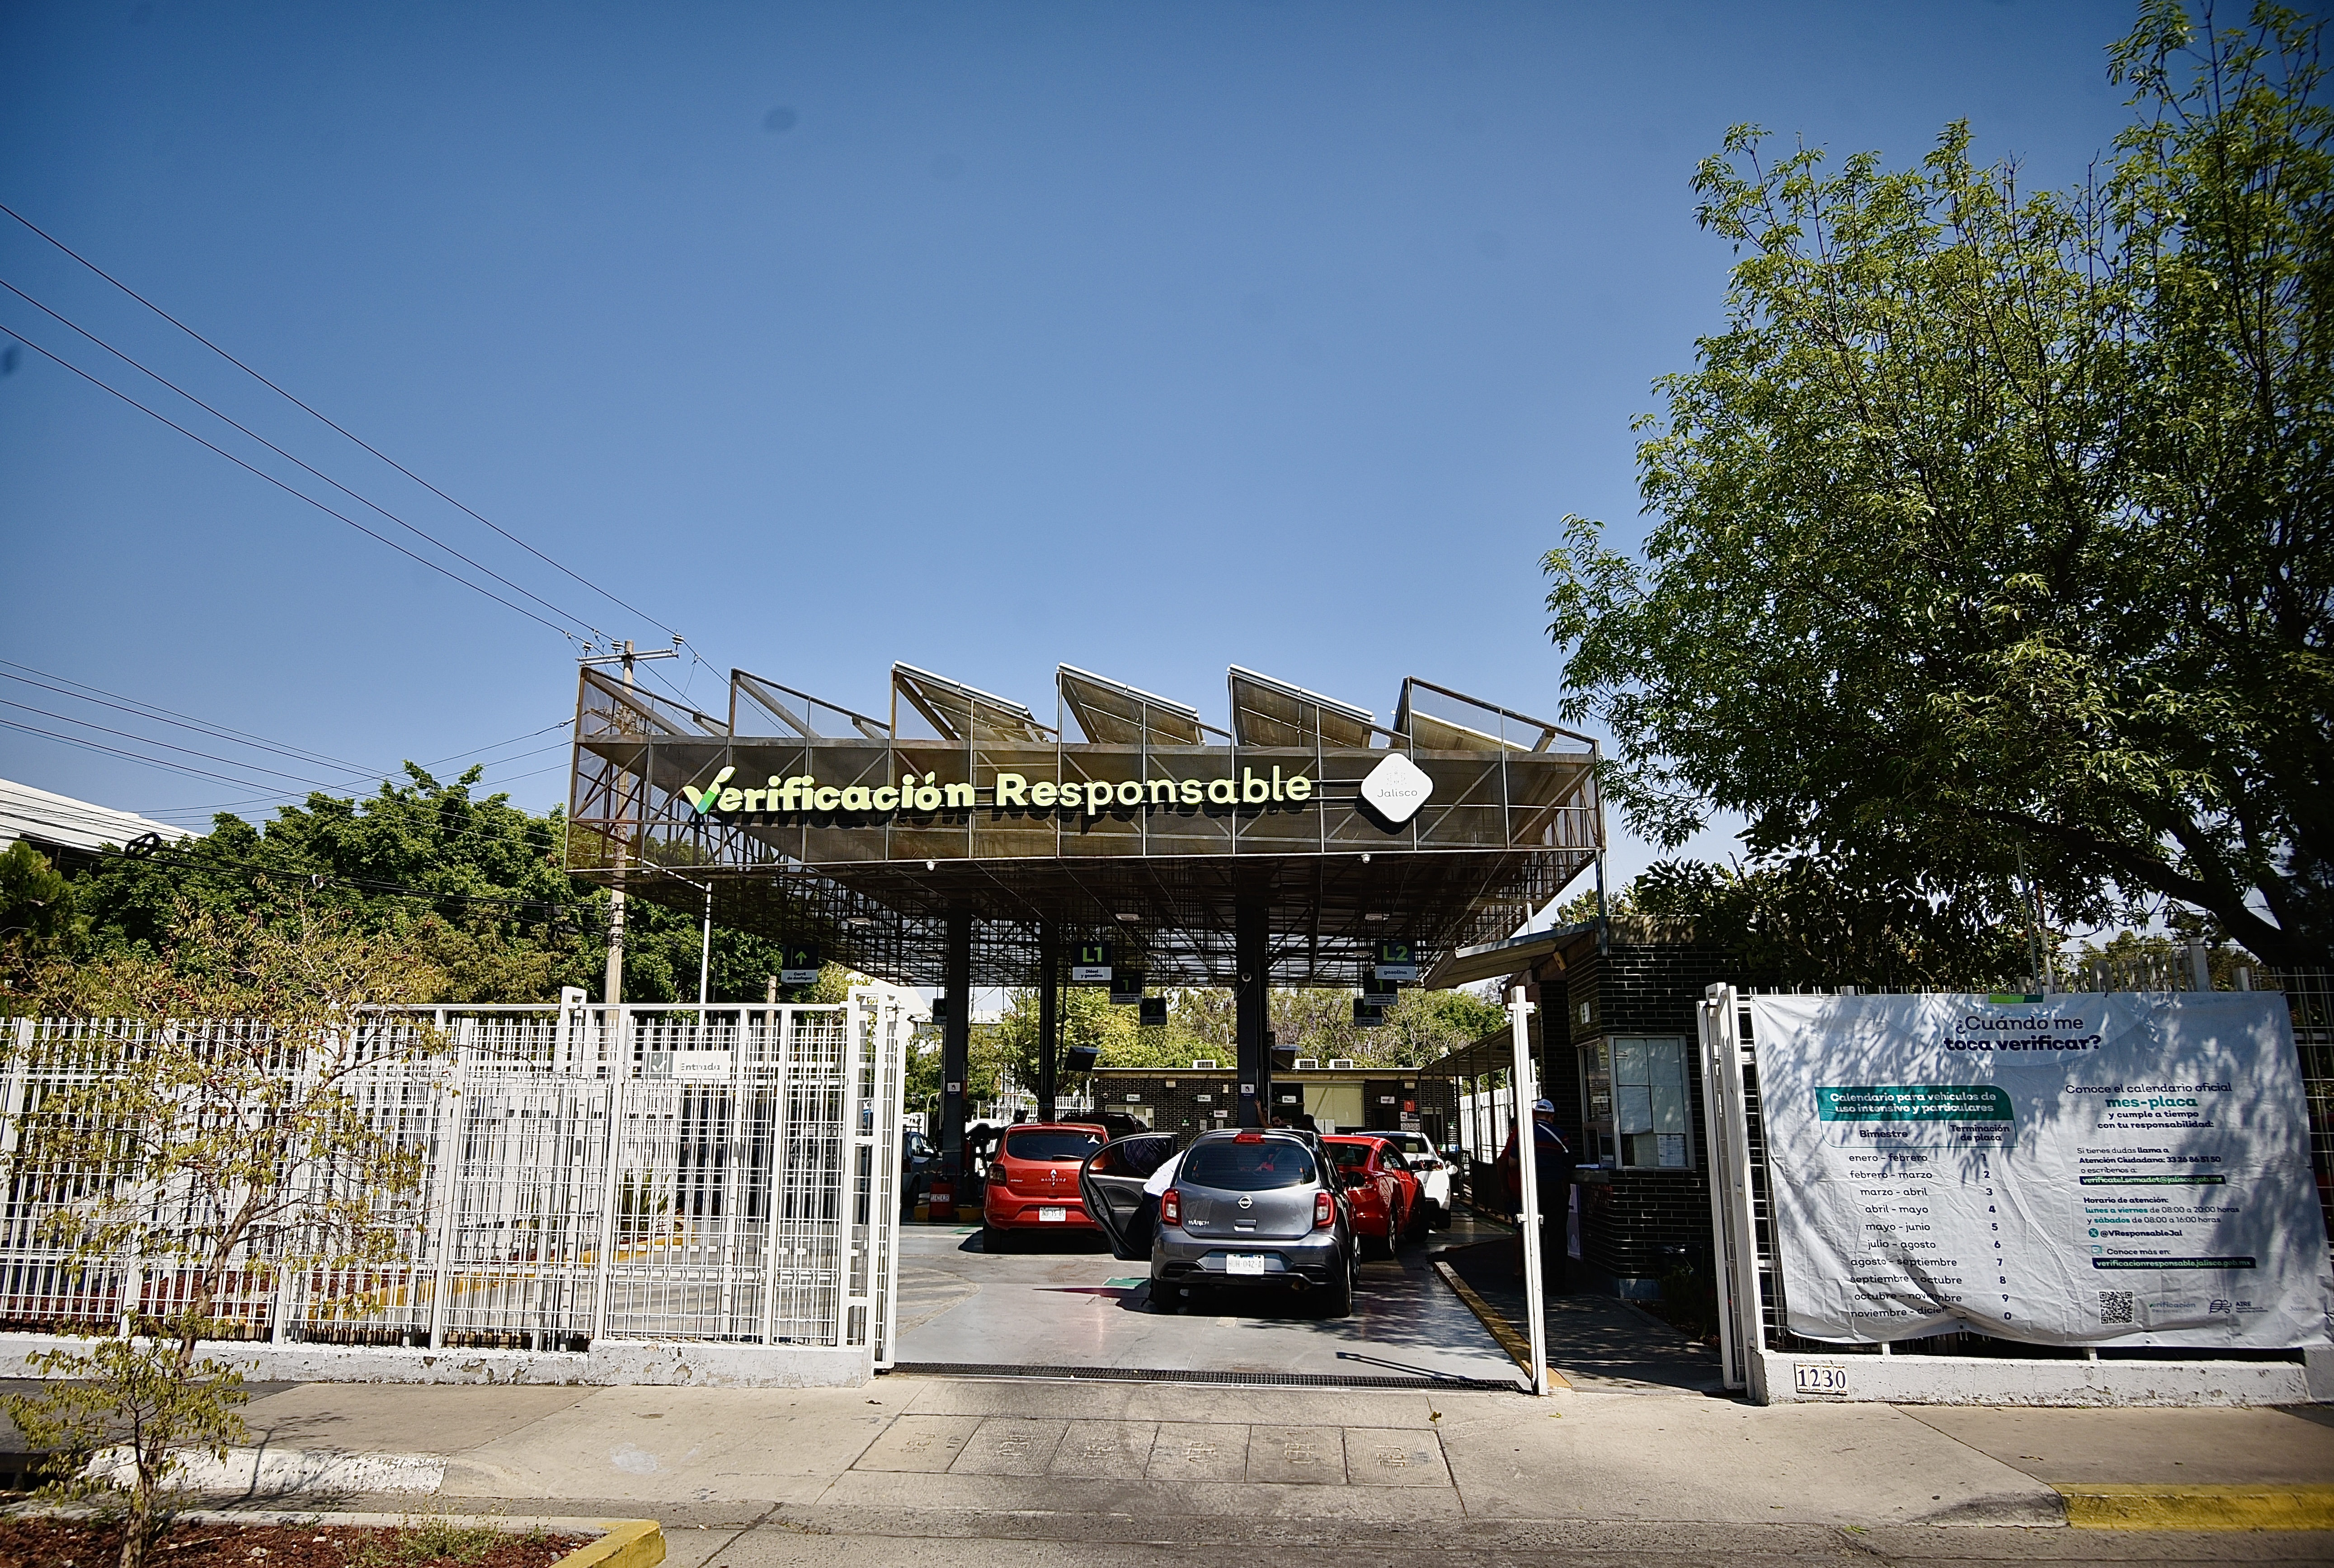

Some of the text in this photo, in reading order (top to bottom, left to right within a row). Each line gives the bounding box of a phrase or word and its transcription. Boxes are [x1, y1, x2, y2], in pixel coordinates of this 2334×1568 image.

[996, 766, 1312, 815] Responsable
[1377, 789, 1417, 797] Jalisco
[1082, 947, 1102, 962] L1
[1383, 946, 1408, 961] L2
[1123, 979, 1129, 991] 1
[1376, 979, 1383, 991] 1
[1149, 1004, 1157, 1014] 2
[1363, 1006, 1372, 1015] 2
[1955, 1016, 2084, 1034] ¿Cuándo me
[1943, 1035, 2102, 1051] toca verificar?
[681, 1062, 720, 1071] Entrada
[2066, 1082, 2233, 1094] Conoce el calendario oficial
[1830, 1092, 1996, 1104] Calendario para vehículos de
[2105, 1096, 2198, 1110] mes-placa
[1858, 1104, 1910, 1113] intensivo
[1912, 1106, 1920, 1114] y
[1923, 1103, 1994, 1114] particulares
[2117, 1111, 2153, 1120] cumple
[2164, 1110, 2199, 1119] tiempo
[1950, 1124, 2010, 1133] Terminación
[2131, 1121, 2214, 1130] responsabilidad:
[1859, 1130, 1908, 1139] Bimestre
[1974, 1134, 2002, 1143] placa
[1888, 1153, 1928, 1162] febrero
[1849, 1171, 1888, 1179] febrero
[1903, 1188, 1928, 1196] abril
[1865, 1205, 1889, 1213] abril
[1899, 1206, 1929, 1215] mayo
[1989, 1205, 1996, 1213] 4
[1865, 1224, 1896, 1232] mayo
[1905, 1223, 1930, 1232] junio
[2101, 1229, 2183, 1238] @VResponsableJal
[1868, 1240, 1889, 1250] julio
[1901, 1241, 1936, 1250] agosto
[1850, 1258, 1887, 1267] agosto
[1897, 1257, 1957, 1267] septiembre
[2096, 1259, 2251, 1268] verificacionresponsable.jalisco.gob.mx
[1850, 1275, 1909, 1285] septiembre
[1920, 1276, 1962, 1285] octubre
[2000, 1276, 2006, 1284] 8
[1854, 1292, 1896, 1300] octubre
[1908, 1291, 1962, 1302] noviembre
[2002, 1294, 2009, 1302] 9
[1851, 1309, 1907, 1317] noviembre
[1917, 1304, 1953, 1314] dicie
[2004, 1312, 2012, 1320] 0
[1798, 1369, 1845, 1389] 1230
